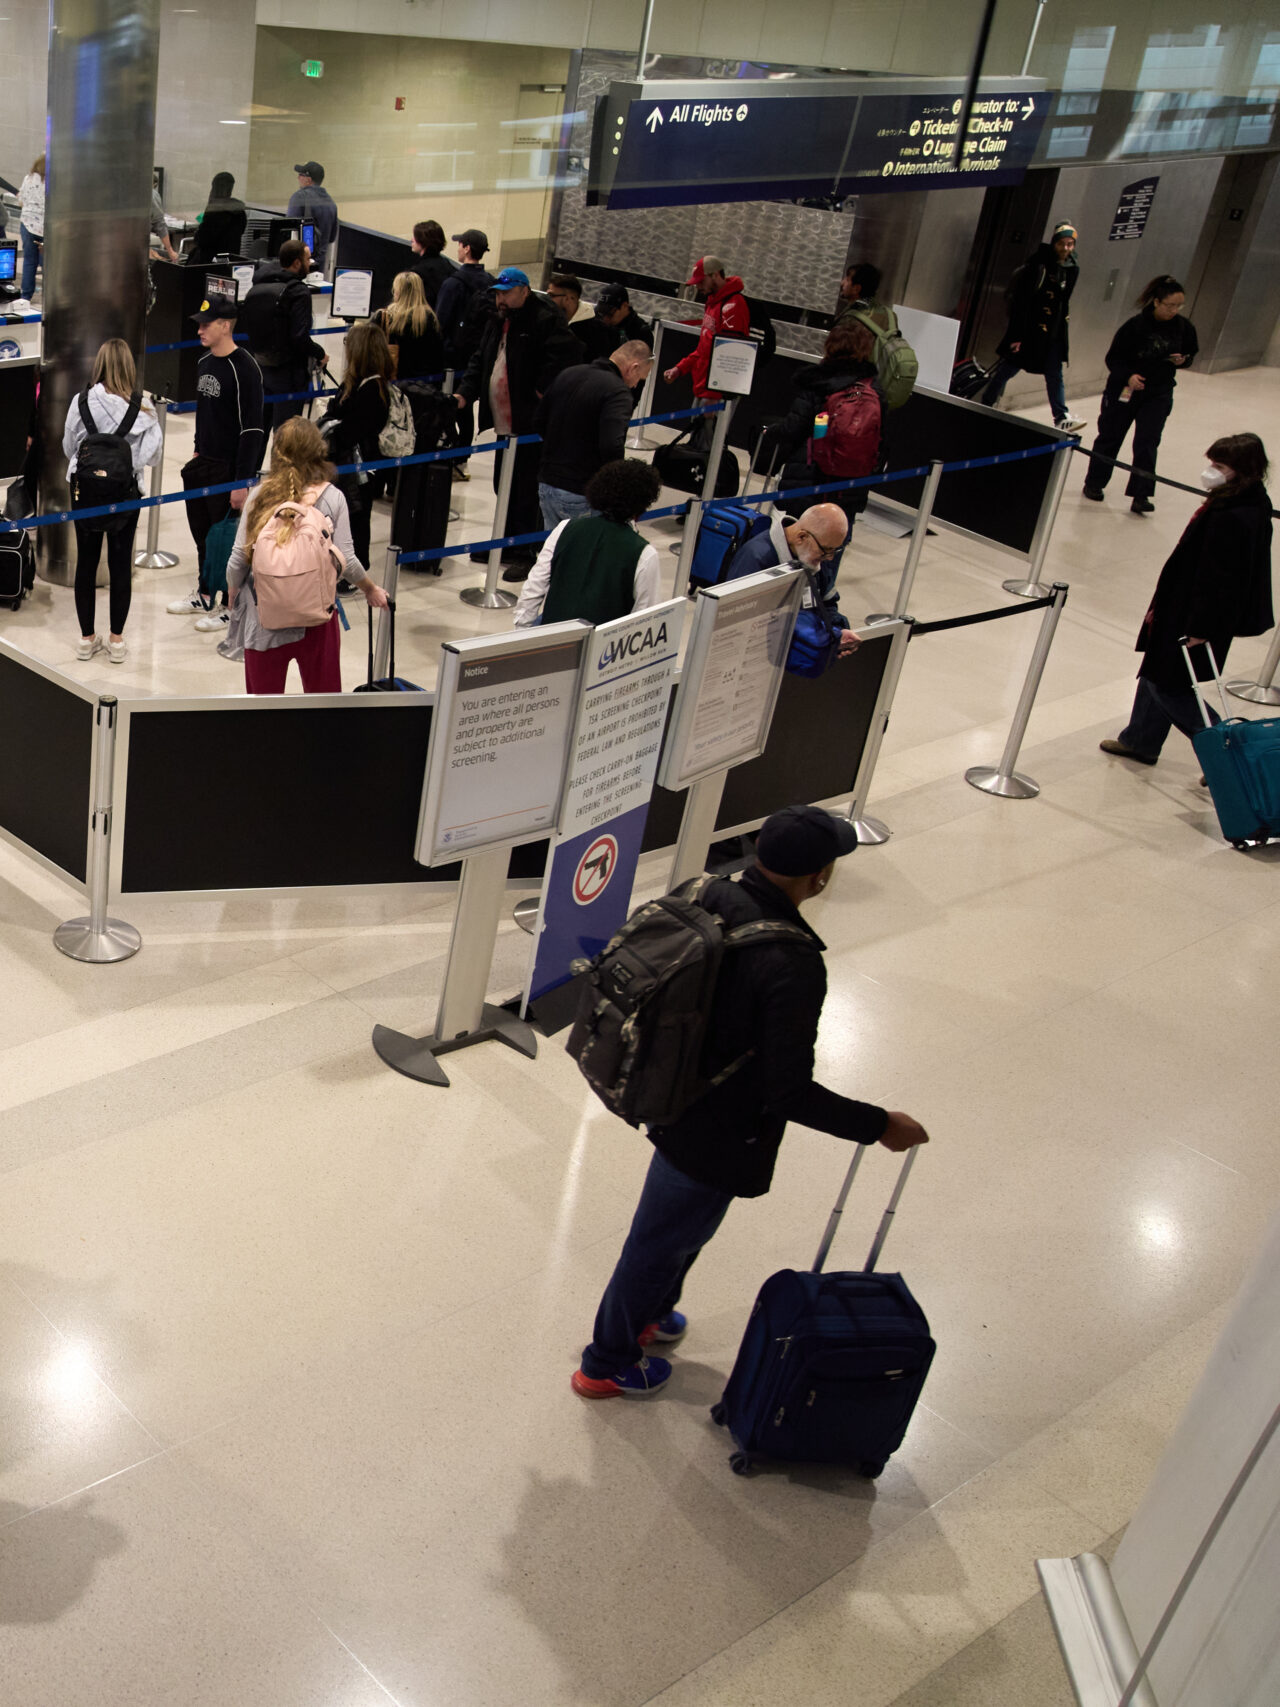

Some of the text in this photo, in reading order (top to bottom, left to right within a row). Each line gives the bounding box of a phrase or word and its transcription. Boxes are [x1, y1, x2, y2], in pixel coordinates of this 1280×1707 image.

[669, 104, 734, 127] All Flights
[1005, 99, 1020, 113] to:
[979, 136, 1007, 153] Claim
[960, 155, 1001, 173] Arrivals
[610, 621, 668, 664] WCAA
[464, 666, 489, 679] Notice
[461, 685, 549, 712] You are entering an
[586, 691, 613, 711] CARRYING
[614, 682, 640, 699] FIREARMS
[641, 672, 665, 687] THROUGH
[458, 697, 561, 727] area where all persons
[588, 687, 663, 726] TSA SCREENING CHECKPOINT
[453, 726, 546, 755] subject to additional
[455, 716, 534, 741] and property are
[577, 735, 586, 747] OF
[587, 731, 596, 742] AN
[596, 720, 620, 738] AIRPORT
[627, 706, 658, 724] PROHIBITED
[577, 718, 662, 763] FEDERAL LAW AND REGULATIONS
[451, 751, 498, 769] screening.
[569, 742, 659, 790] PLEASE CHECK CARRY-ON BAGGAGE
[582, 764, 642, 799] FOR FIREARMS BEFORE
[575, 779, 643, 818] ENTERING THE SCREENING
[590, 803, 623, 826] CHECKPOINT
